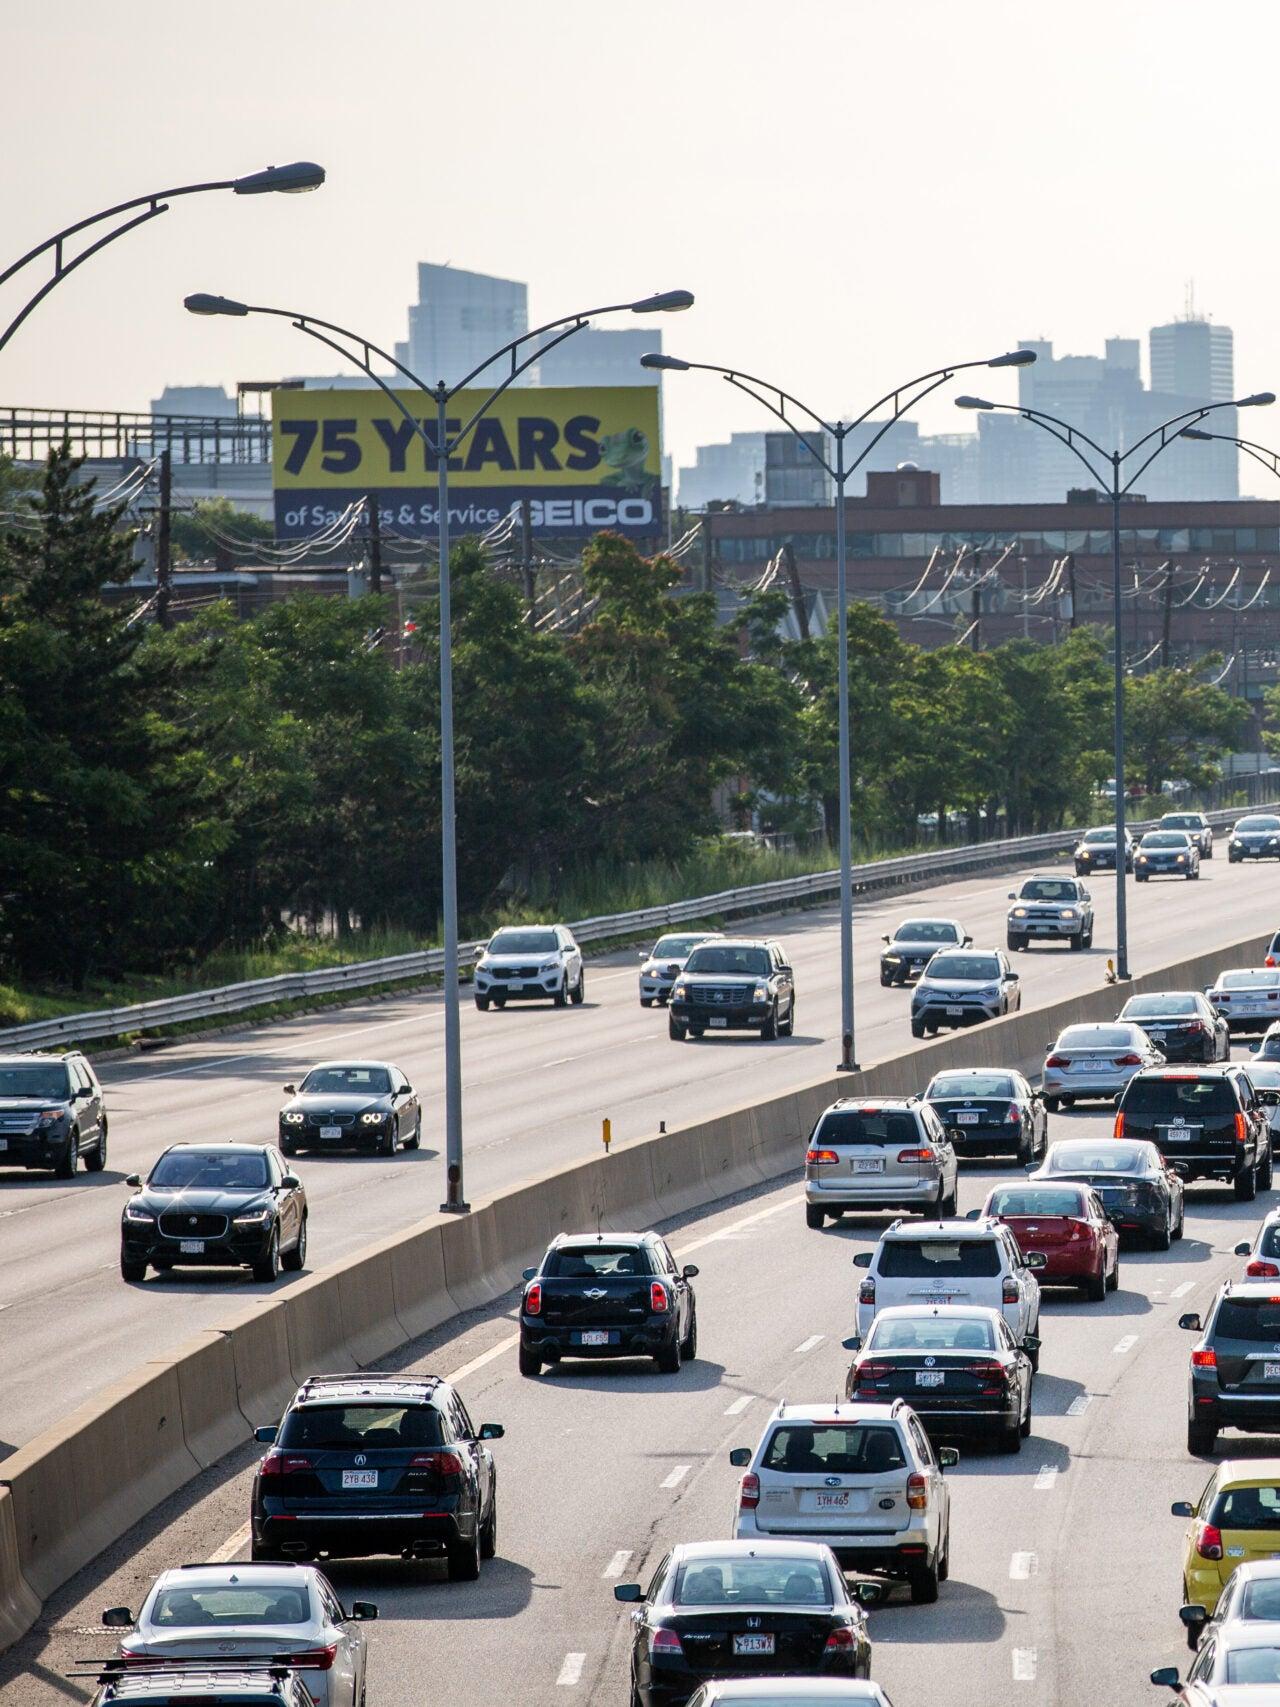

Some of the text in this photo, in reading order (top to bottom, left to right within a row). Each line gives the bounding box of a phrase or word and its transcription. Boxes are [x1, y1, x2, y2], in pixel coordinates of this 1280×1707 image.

[279, 415, 602, 475] 75 YEARS
[284, 504, 309, 527] of
[397, 503, 417, 525] &
[419, 503, 500, 525] Service
[510, 498, 653, 527] GEICO
[344, 1474, 376, 1484] 2YB 438
[816, 1495, 849, 1506] 1YH 465
